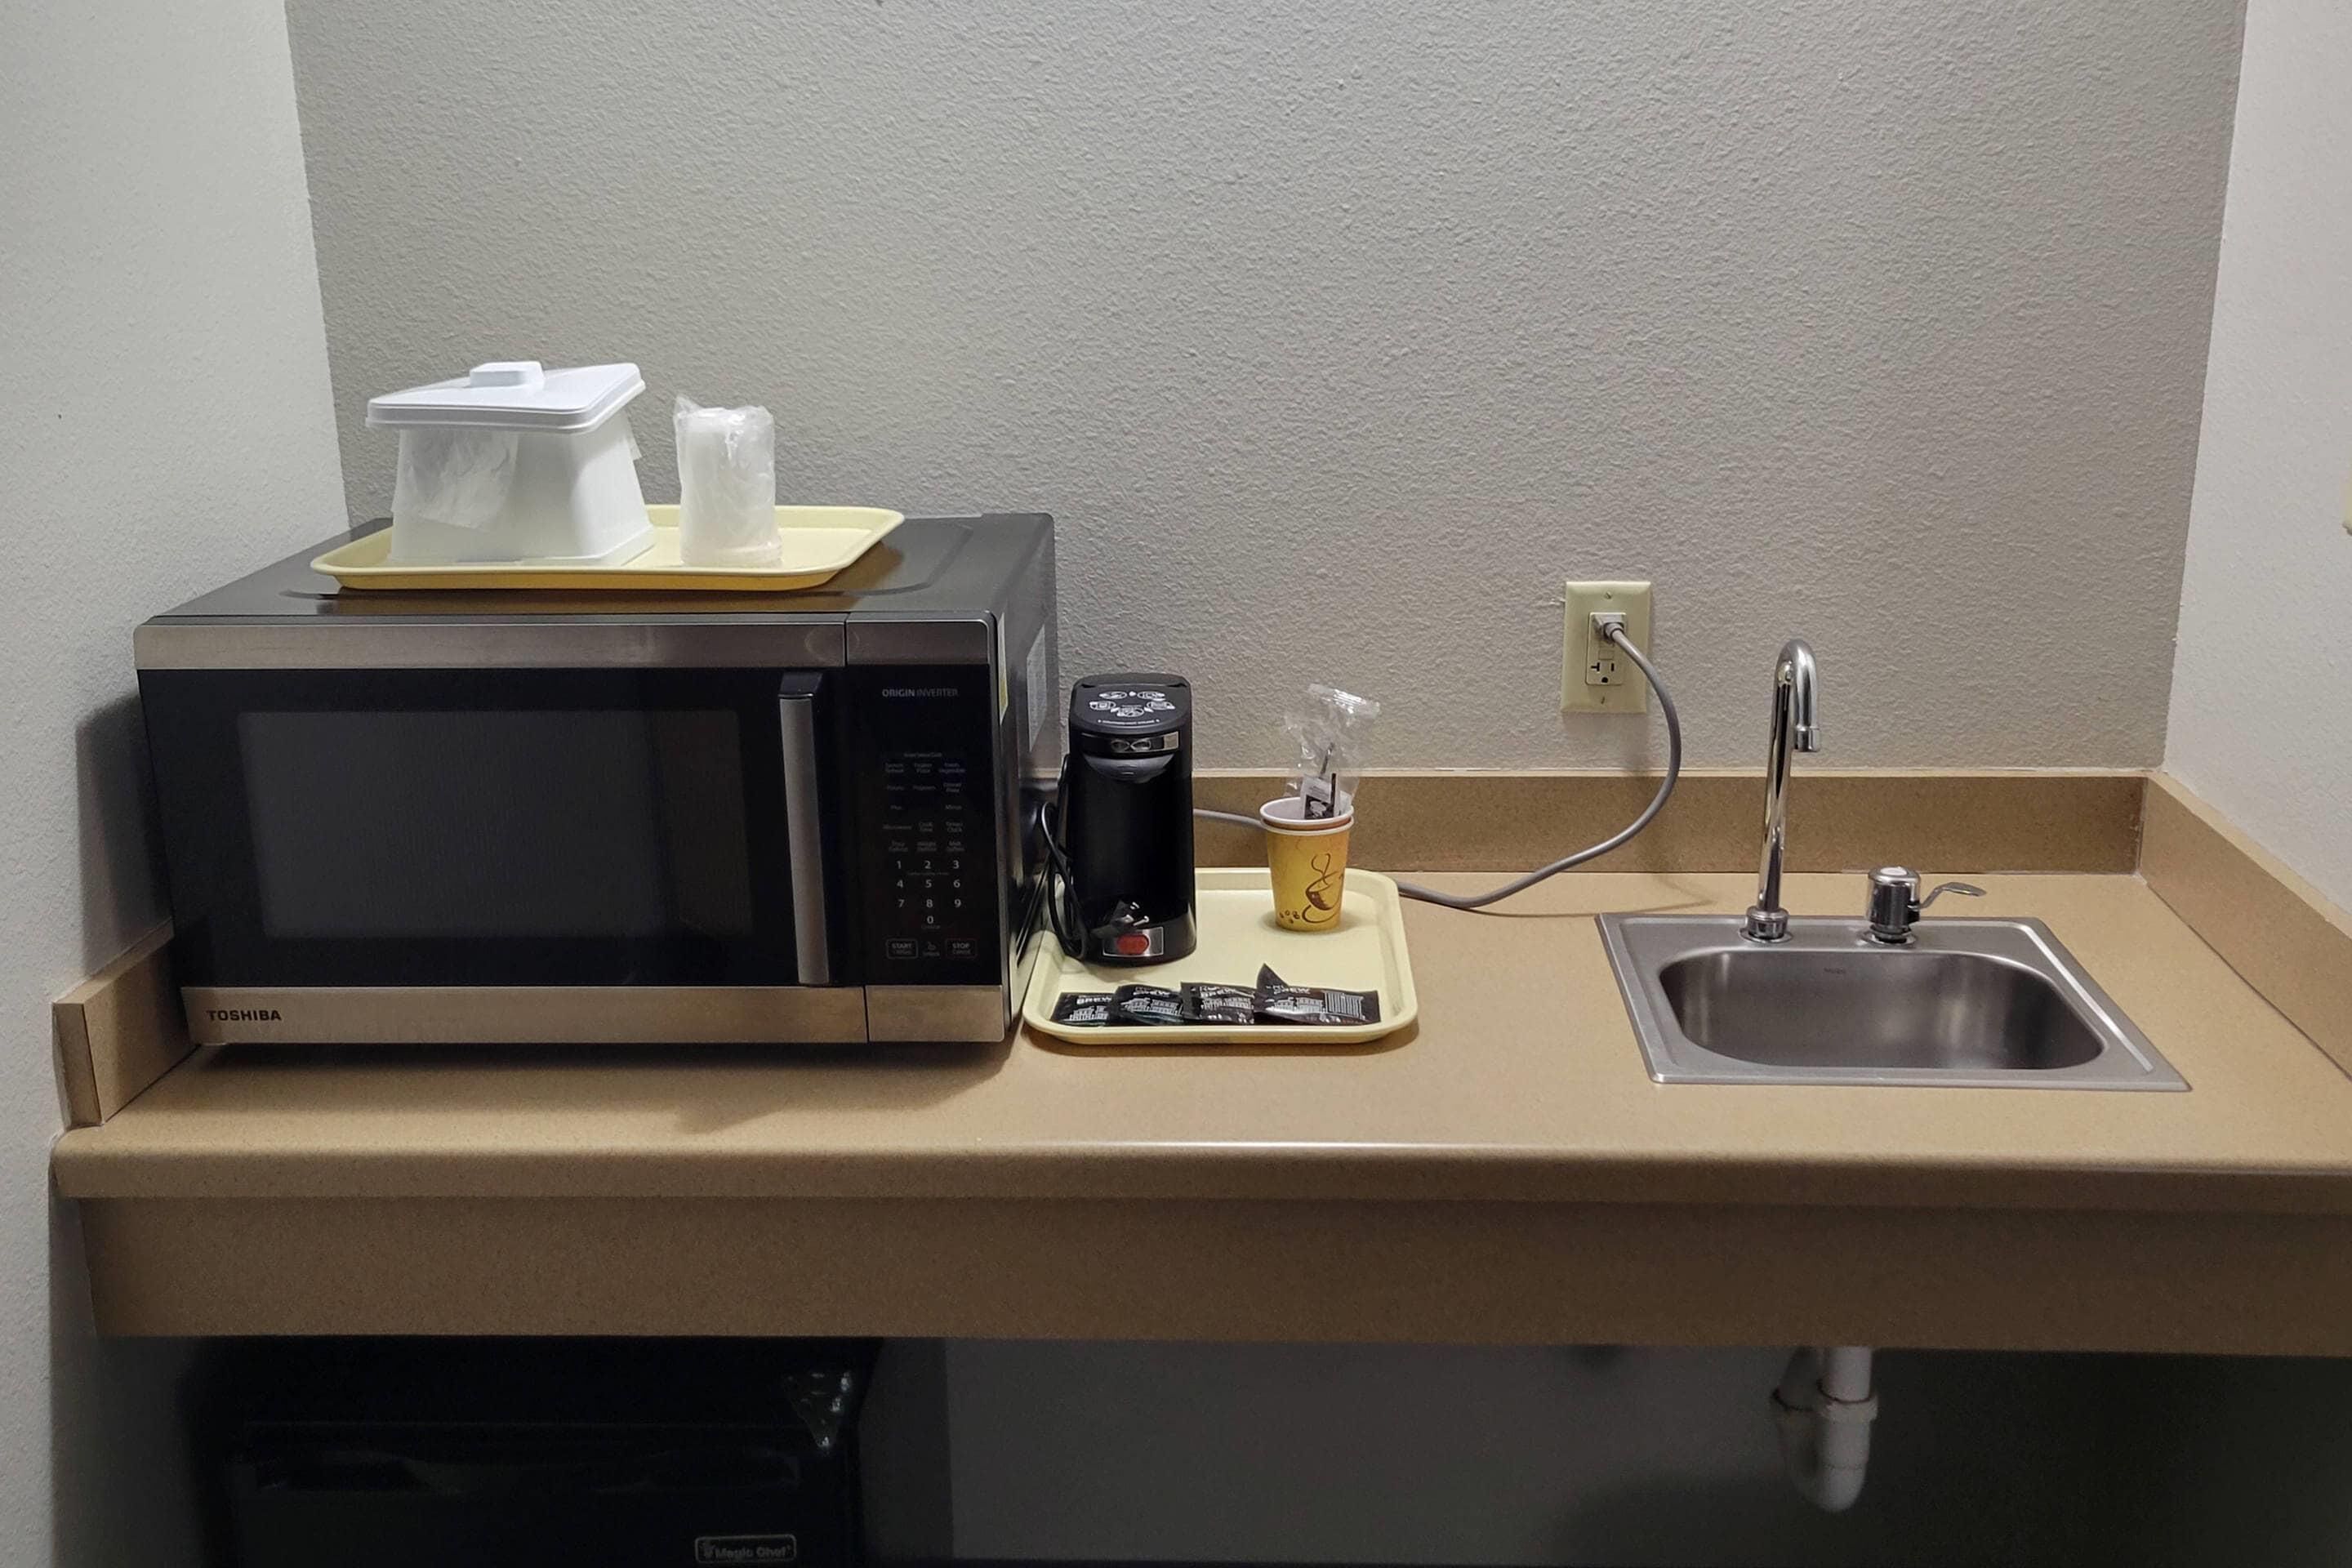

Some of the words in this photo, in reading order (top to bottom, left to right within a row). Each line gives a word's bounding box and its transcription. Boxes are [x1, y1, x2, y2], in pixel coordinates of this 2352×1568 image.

[882, 688, 915, 697] ORIGIN
[916, 688, 958, 697] INVERTER
[897, 861, 902, 869] 1
[924, 861, 932, 869] 2
[953, 860, 960, 869] 3
[897, 880, 903, 888] 4
[925, 880, 932, 888] 5
[954, 880, 960, 888] 6
[898, 899, 905, 907] 7
[926, 899, 933, 908] 8
[955, 899, 961, 907] 9
[927, 915, 933, 924] 0
[1076, 996, 1111, 1005] BREW
[206, 1009, 282, 1021] TOSHIBA
